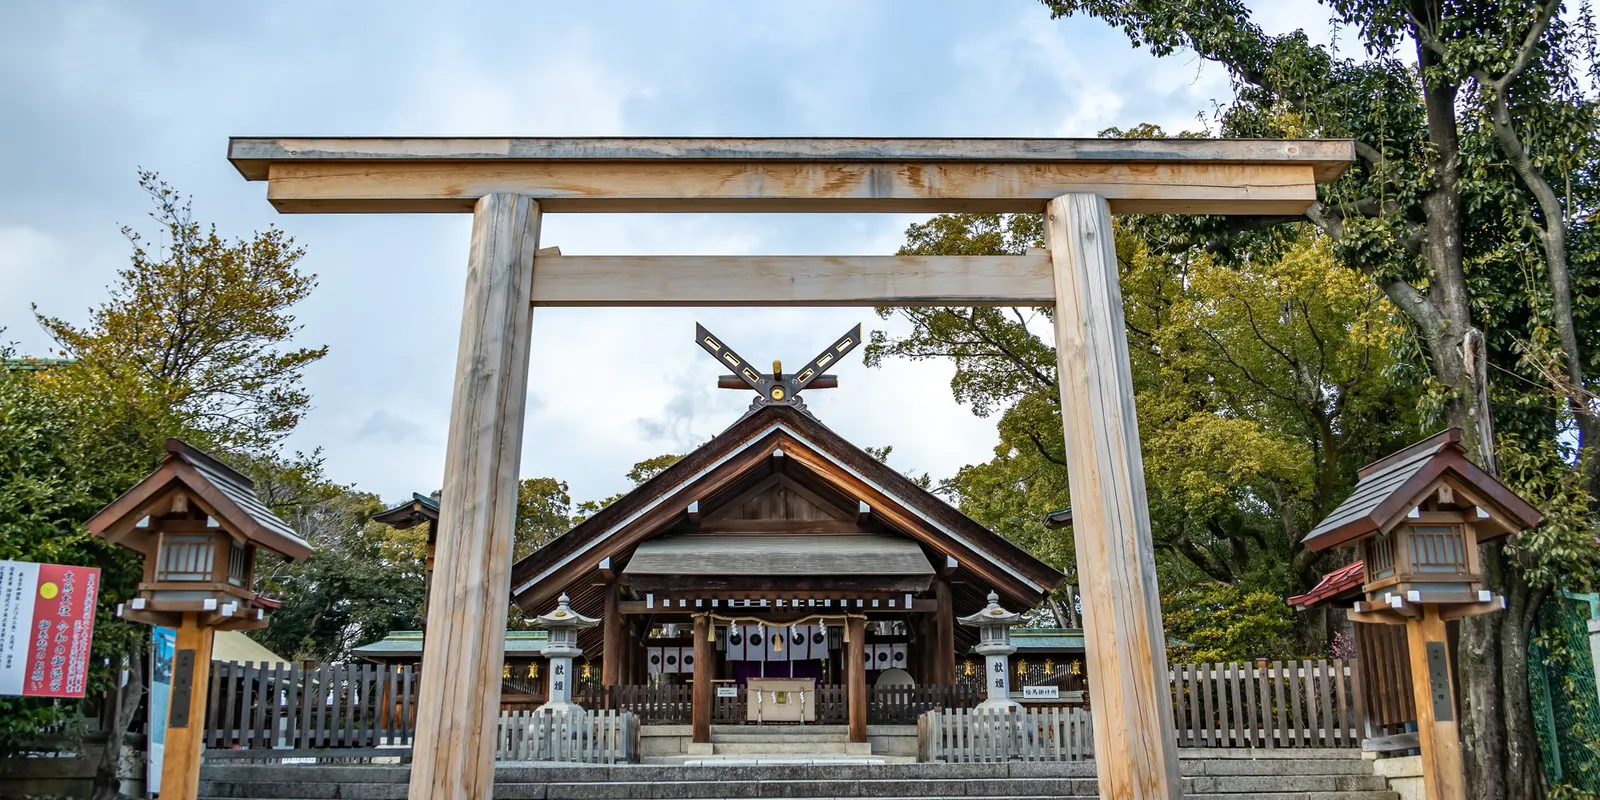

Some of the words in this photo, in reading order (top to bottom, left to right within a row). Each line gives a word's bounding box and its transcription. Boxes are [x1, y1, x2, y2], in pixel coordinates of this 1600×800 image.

[57, 570, 76, 617] 大鳥大社
[1025, 688, 1057, 696] 絵馬掛け所
